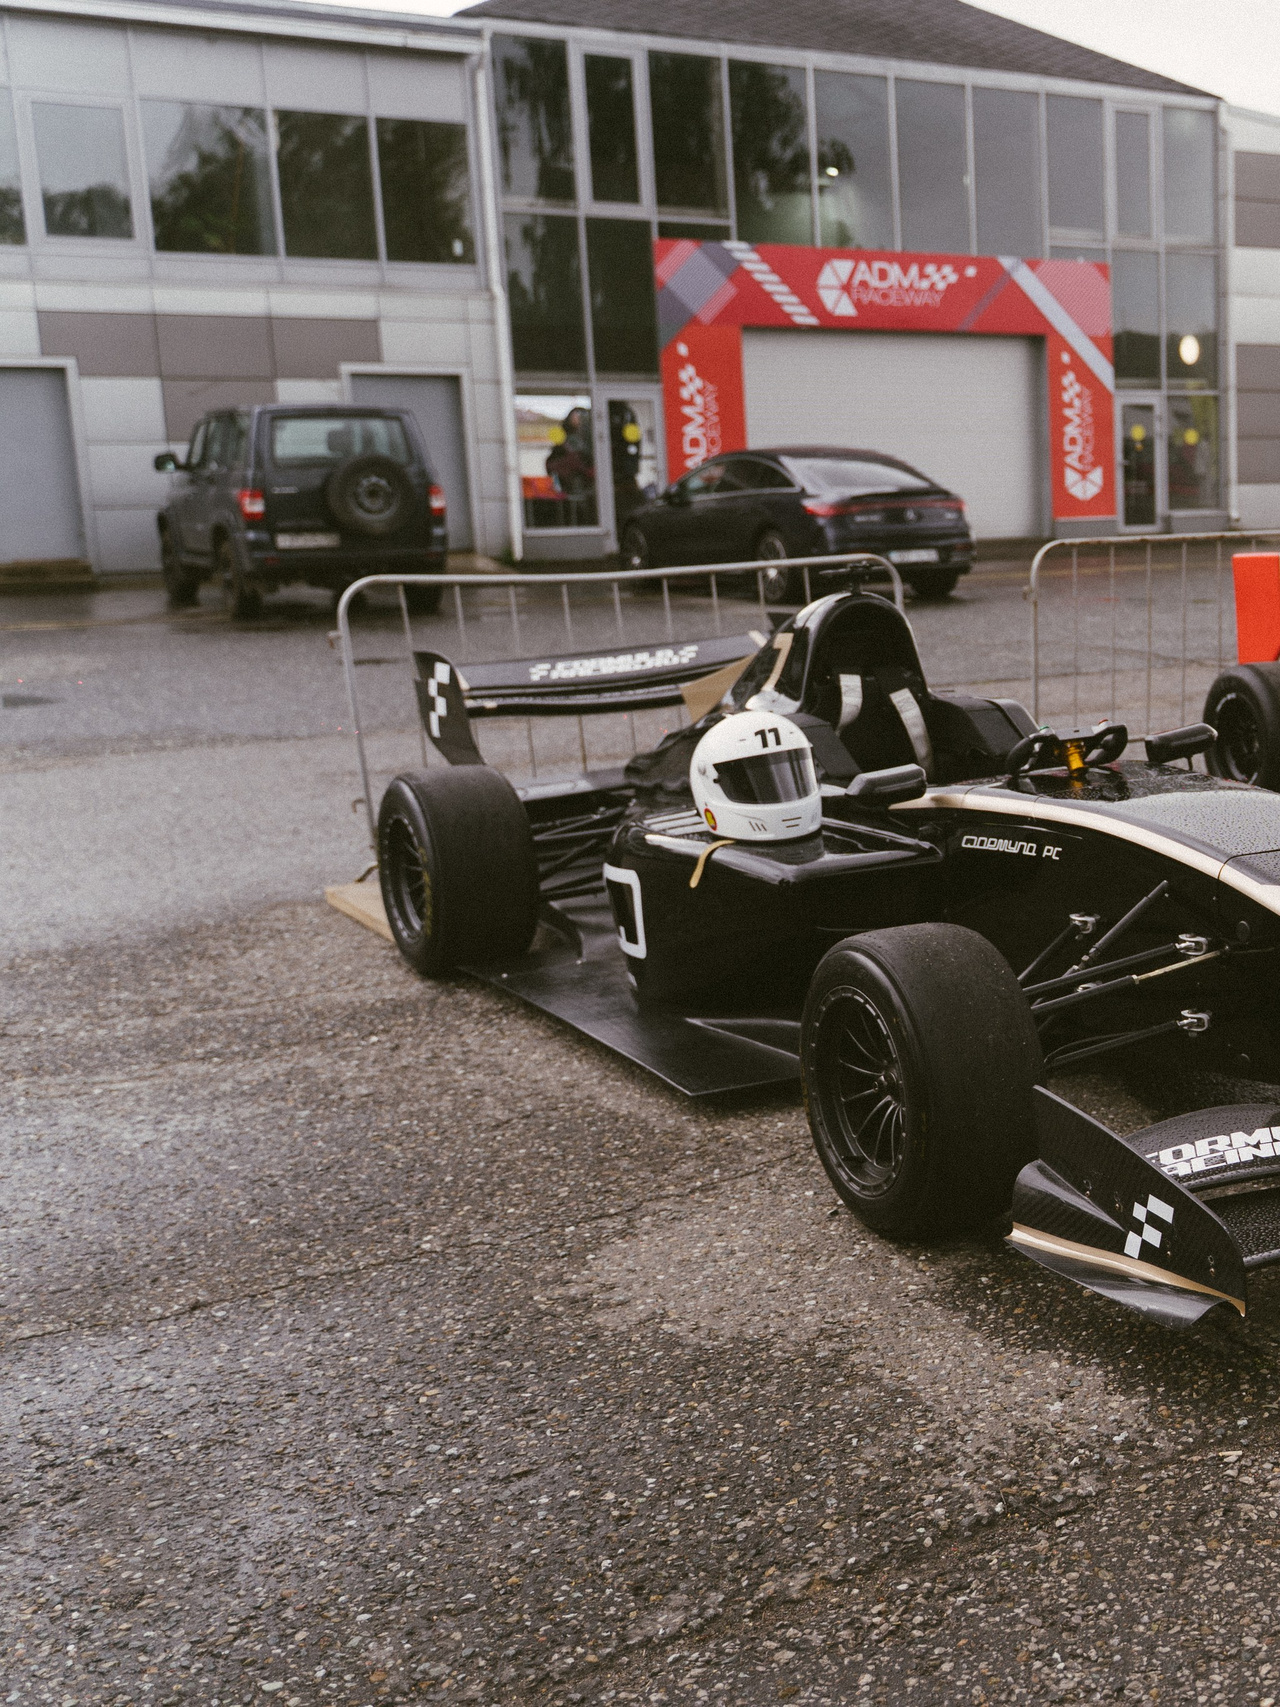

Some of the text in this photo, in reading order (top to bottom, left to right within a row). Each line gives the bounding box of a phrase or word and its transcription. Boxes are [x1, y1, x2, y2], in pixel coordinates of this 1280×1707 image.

[851, 259, 920, 289] ADM
[1062, 407, 1085, 471] ADM
[754, 727, 782, 749] 11
